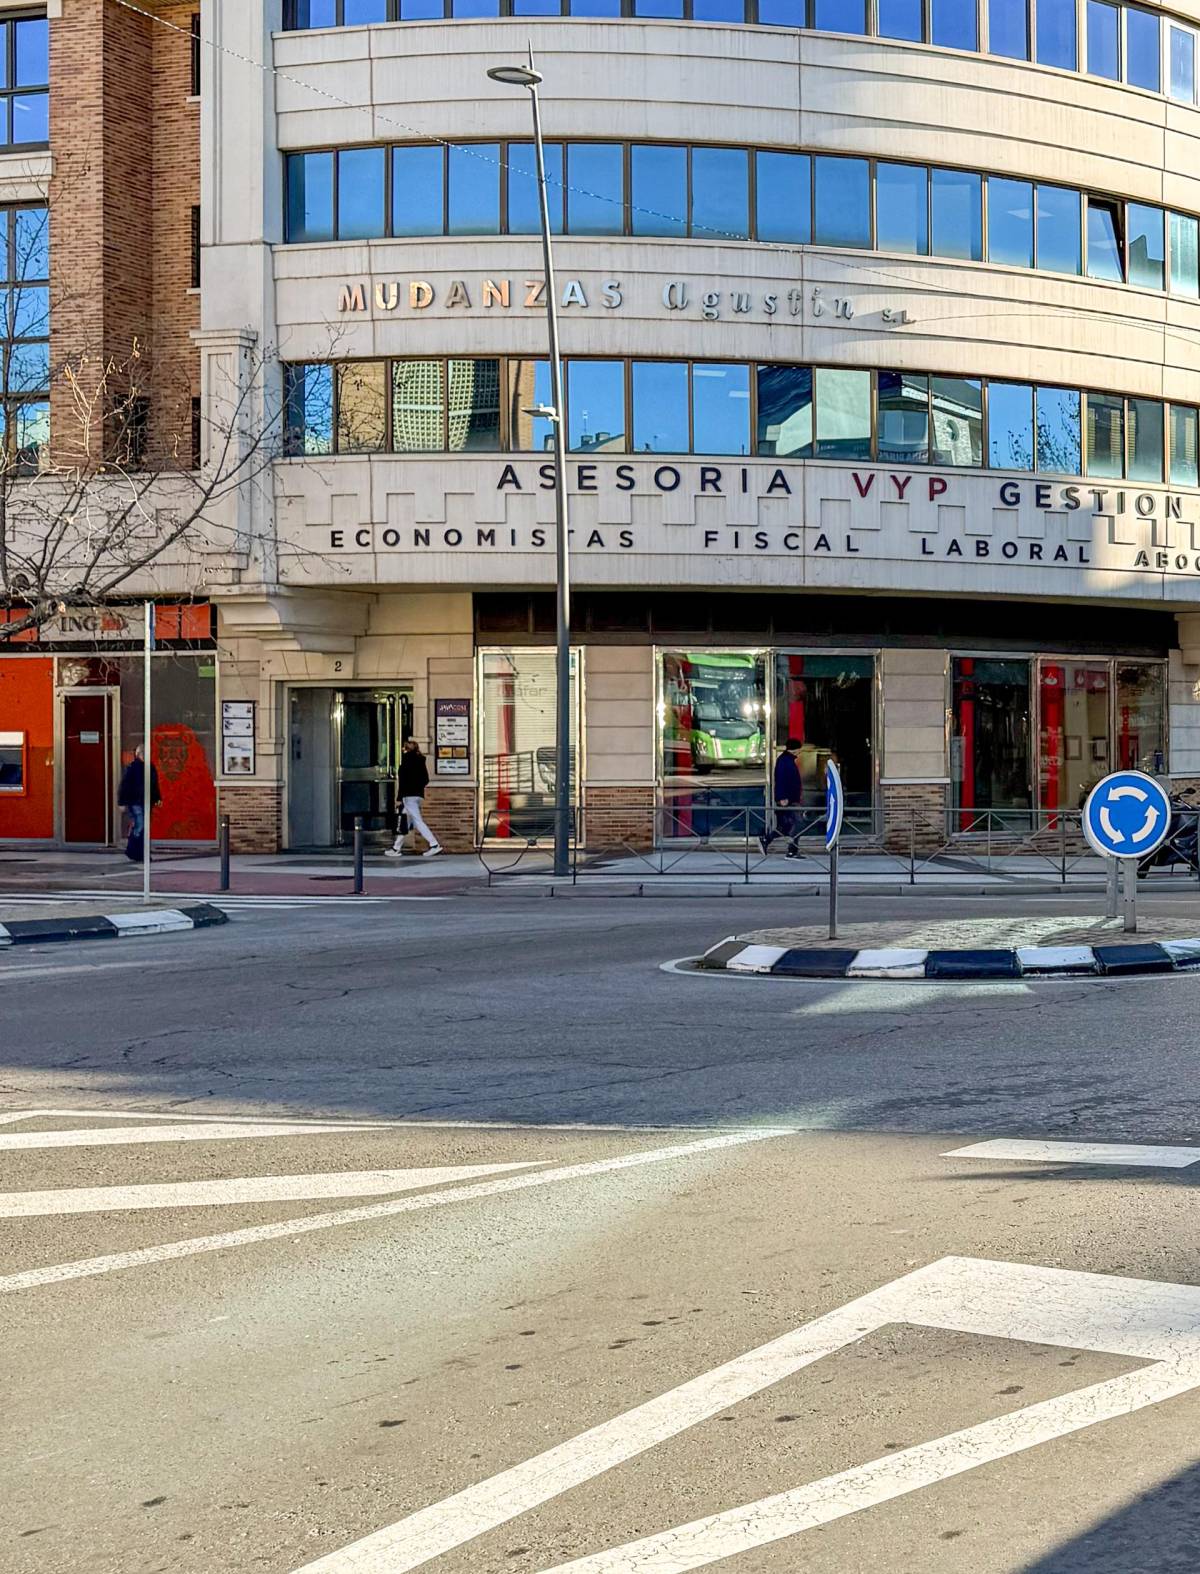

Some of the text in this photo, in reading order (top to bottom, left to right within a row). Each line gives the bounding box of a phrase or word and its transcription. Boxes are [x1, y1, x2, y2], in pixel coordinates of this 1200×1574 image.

[338, 279, 622, 312] MUDANZAS
[663, 280, 854, 321] Agustin
[497, 464, 1182, 519] ASESORIA VYP GESTION
[705, 531, 859, 552] FISCAL
[921, 538, 1090, 563] LABORAL
[61, 615, 98, 632] ING
[335, 660, 342, 672] 2
